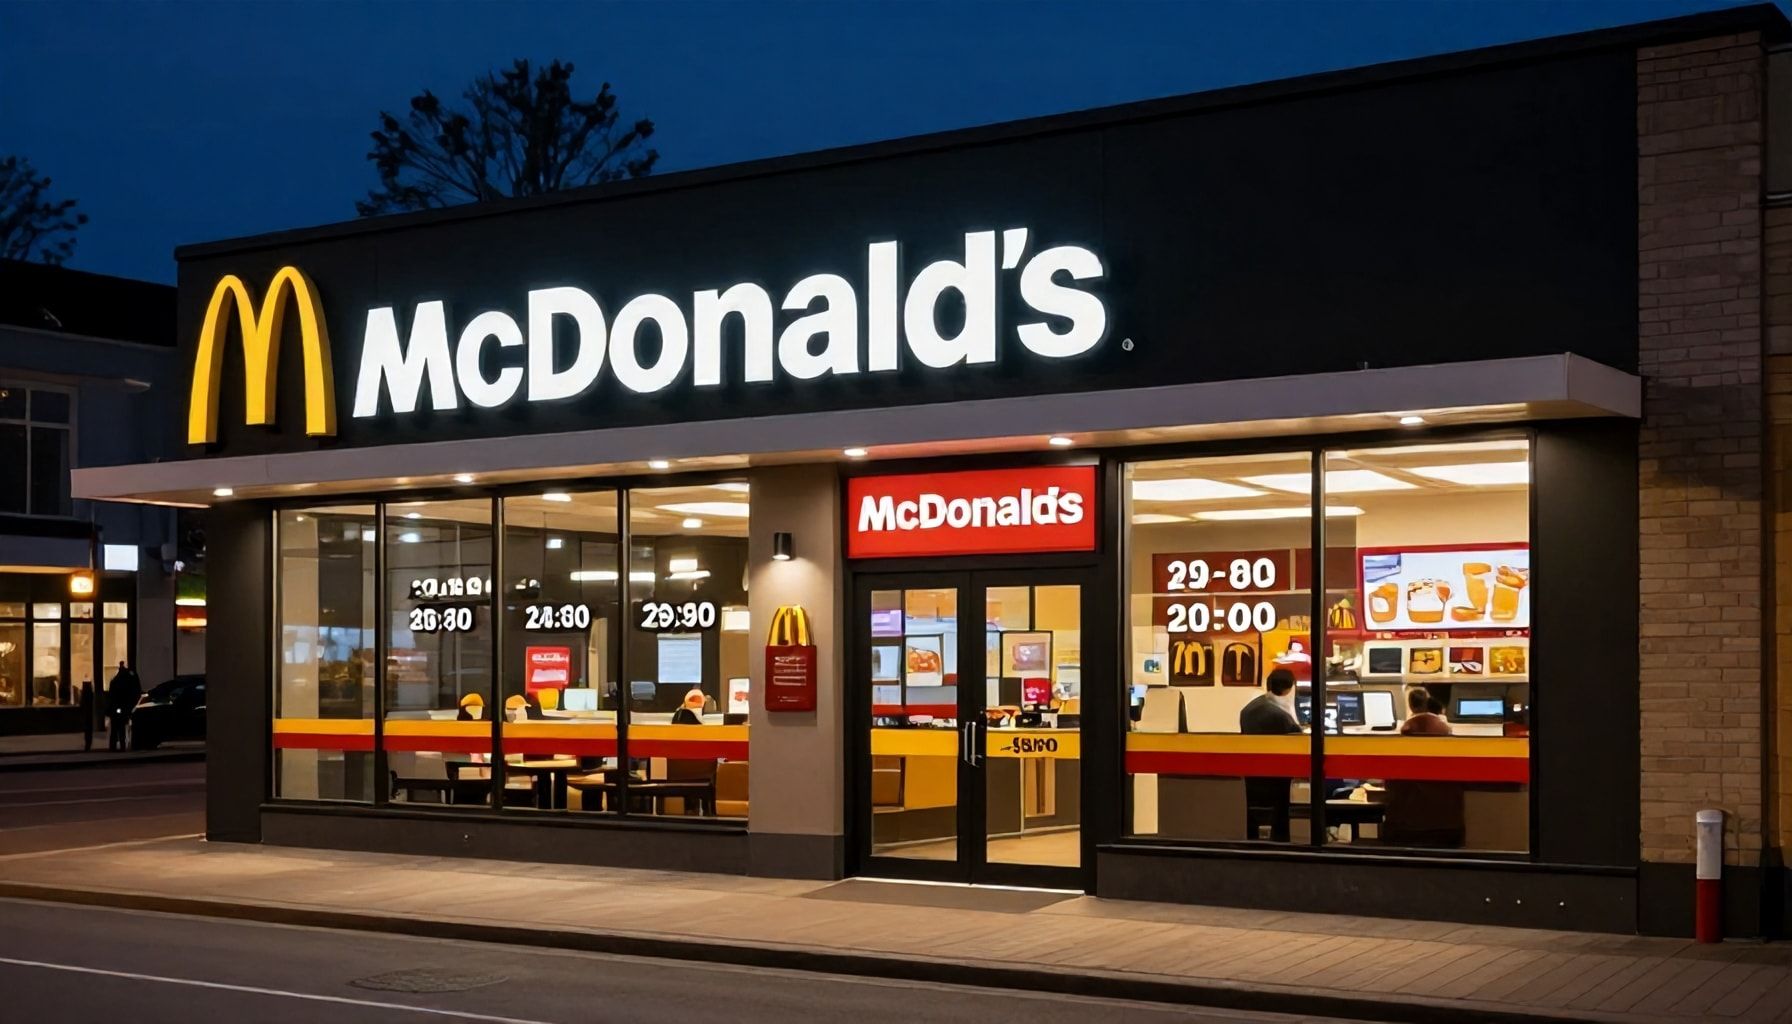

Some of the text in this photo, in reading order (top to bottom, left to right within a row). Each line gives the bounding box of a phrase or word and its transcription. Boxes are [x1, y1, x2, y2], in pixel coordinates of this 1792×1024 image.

[353, 228, 1105, 417] McDonald's
[858, 486, 1083, 532] McDonald's
[1167, 558, 1276, 590] 29-80
[1167, 602, 1276, 632] 20:00
